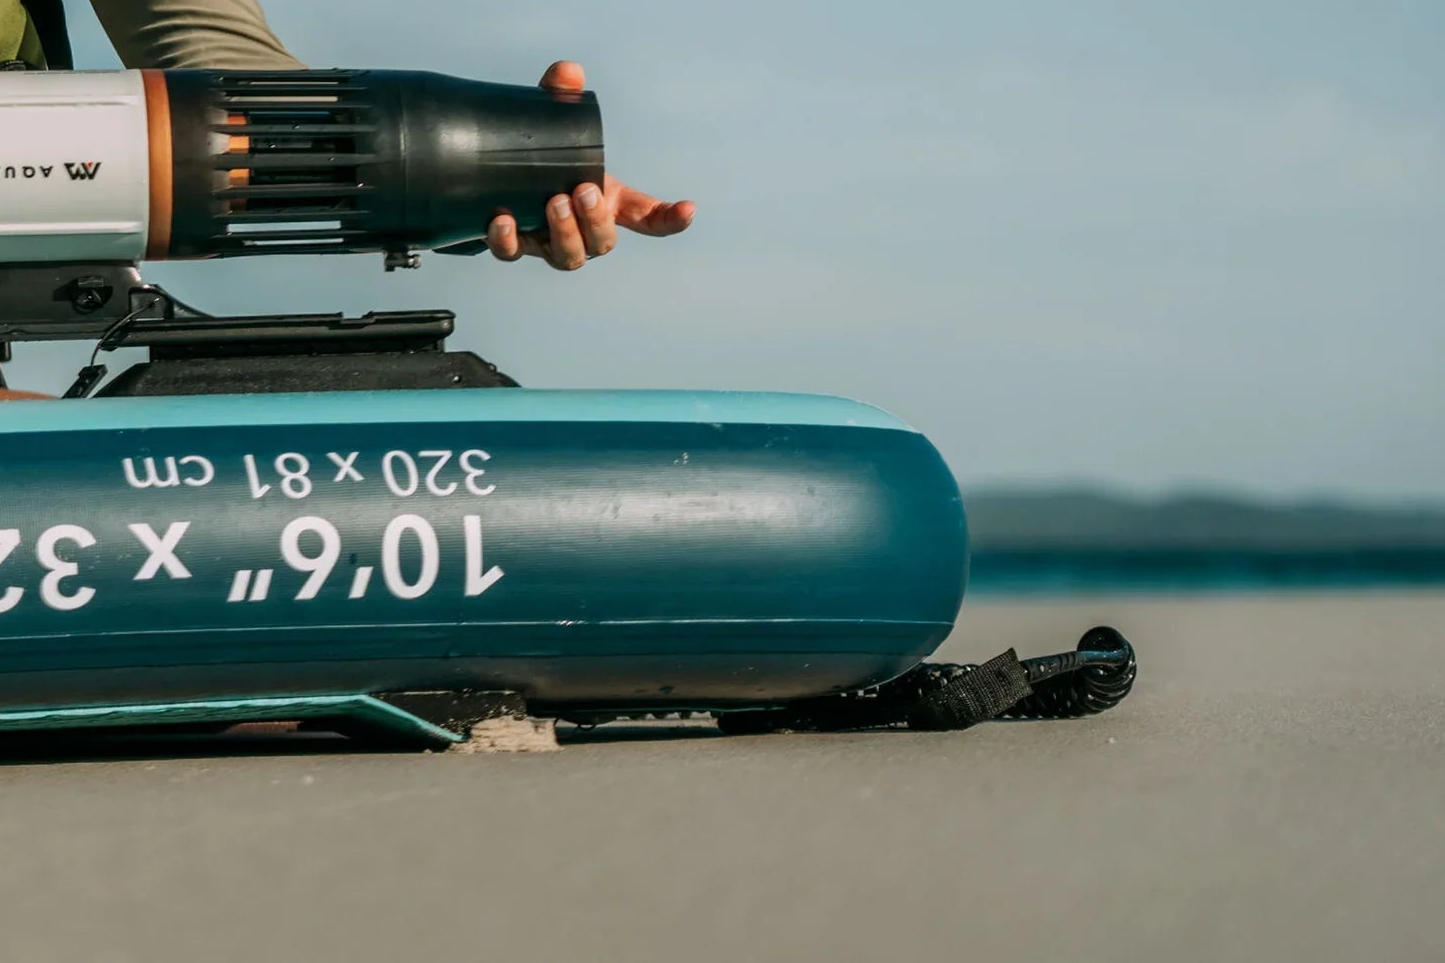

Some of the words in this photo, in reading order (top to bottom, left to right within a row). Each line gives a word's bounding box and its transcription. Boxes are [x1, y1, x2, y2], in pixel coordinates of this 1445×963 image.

[122, 454, 215, 489] cm
[243, 451, 313, 500] 81
[326, 450, 365, 483] x
[382, 448, 498, 498] 320
[126, 520, 193, 581] x
